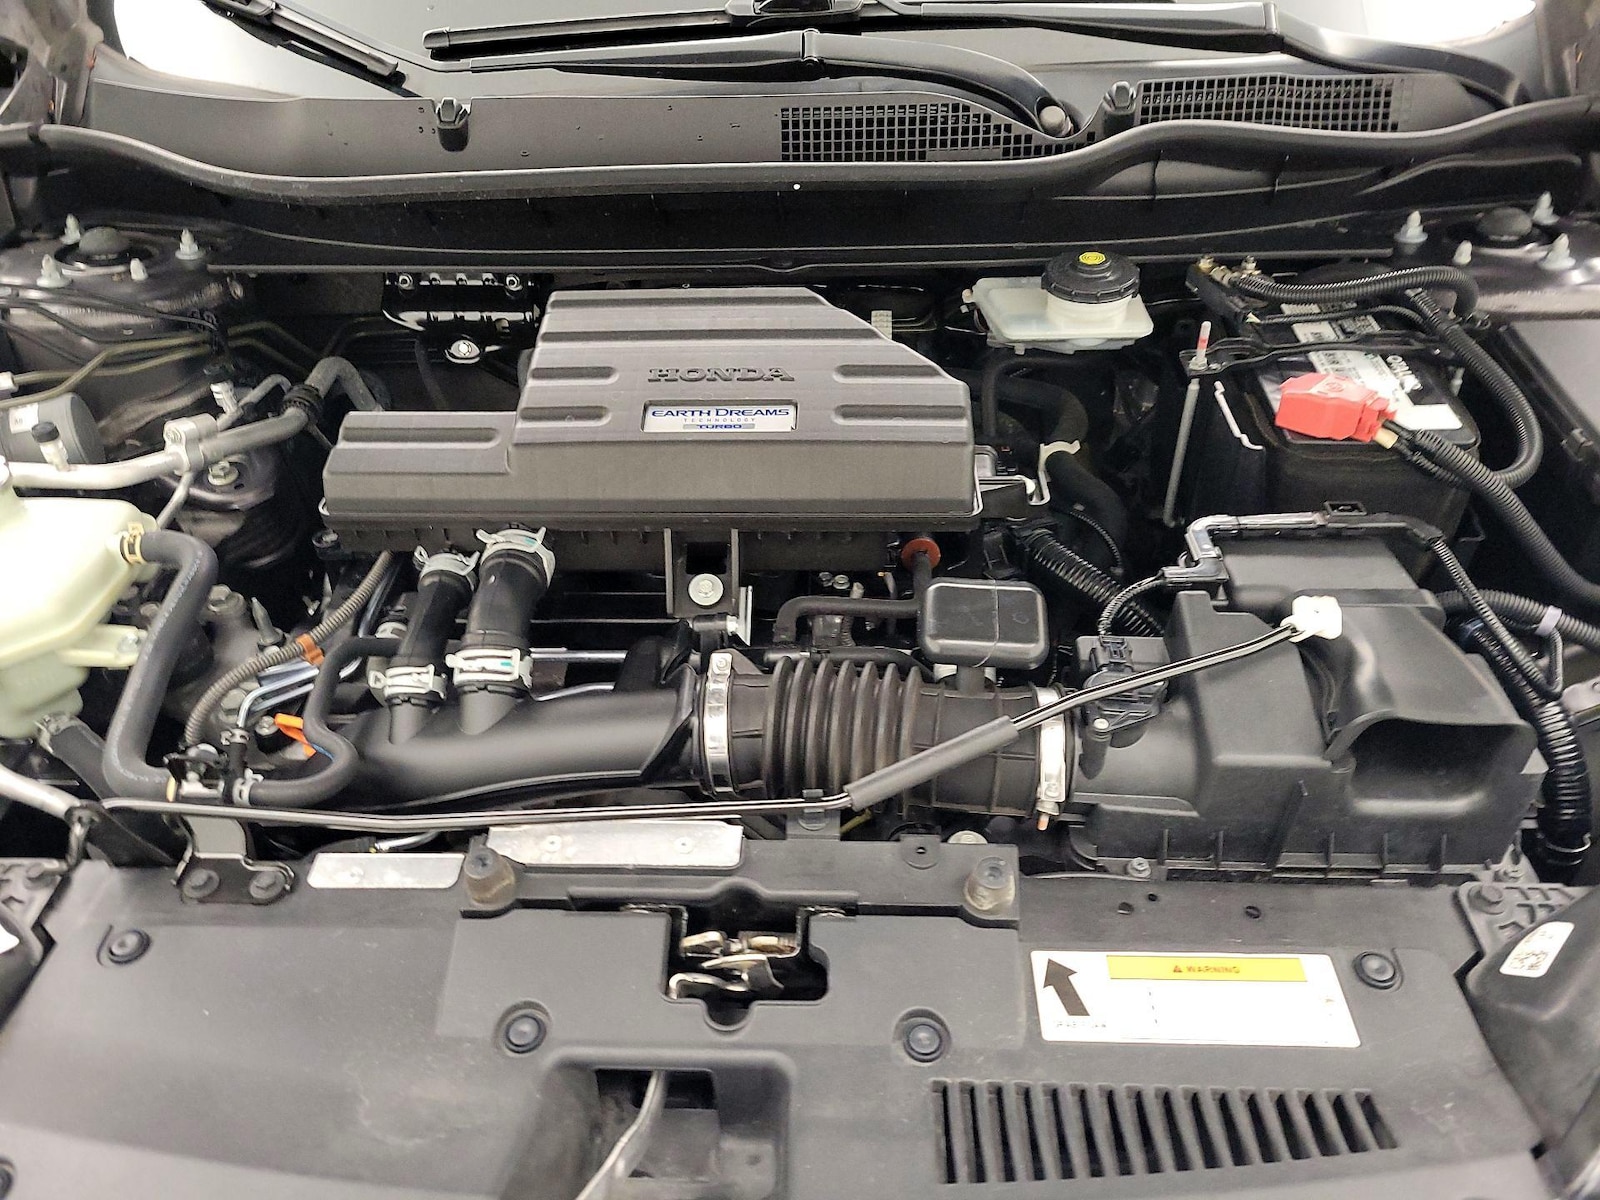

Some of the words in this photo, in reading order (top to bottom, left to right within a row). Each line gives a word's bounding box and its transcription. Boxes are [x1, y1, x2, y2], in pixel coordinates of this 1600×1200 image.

[648, 367, 795, 382] HONDA
[651, 409, 711, 418] EARTH
[715, 408, 790, 417] DREAMS
